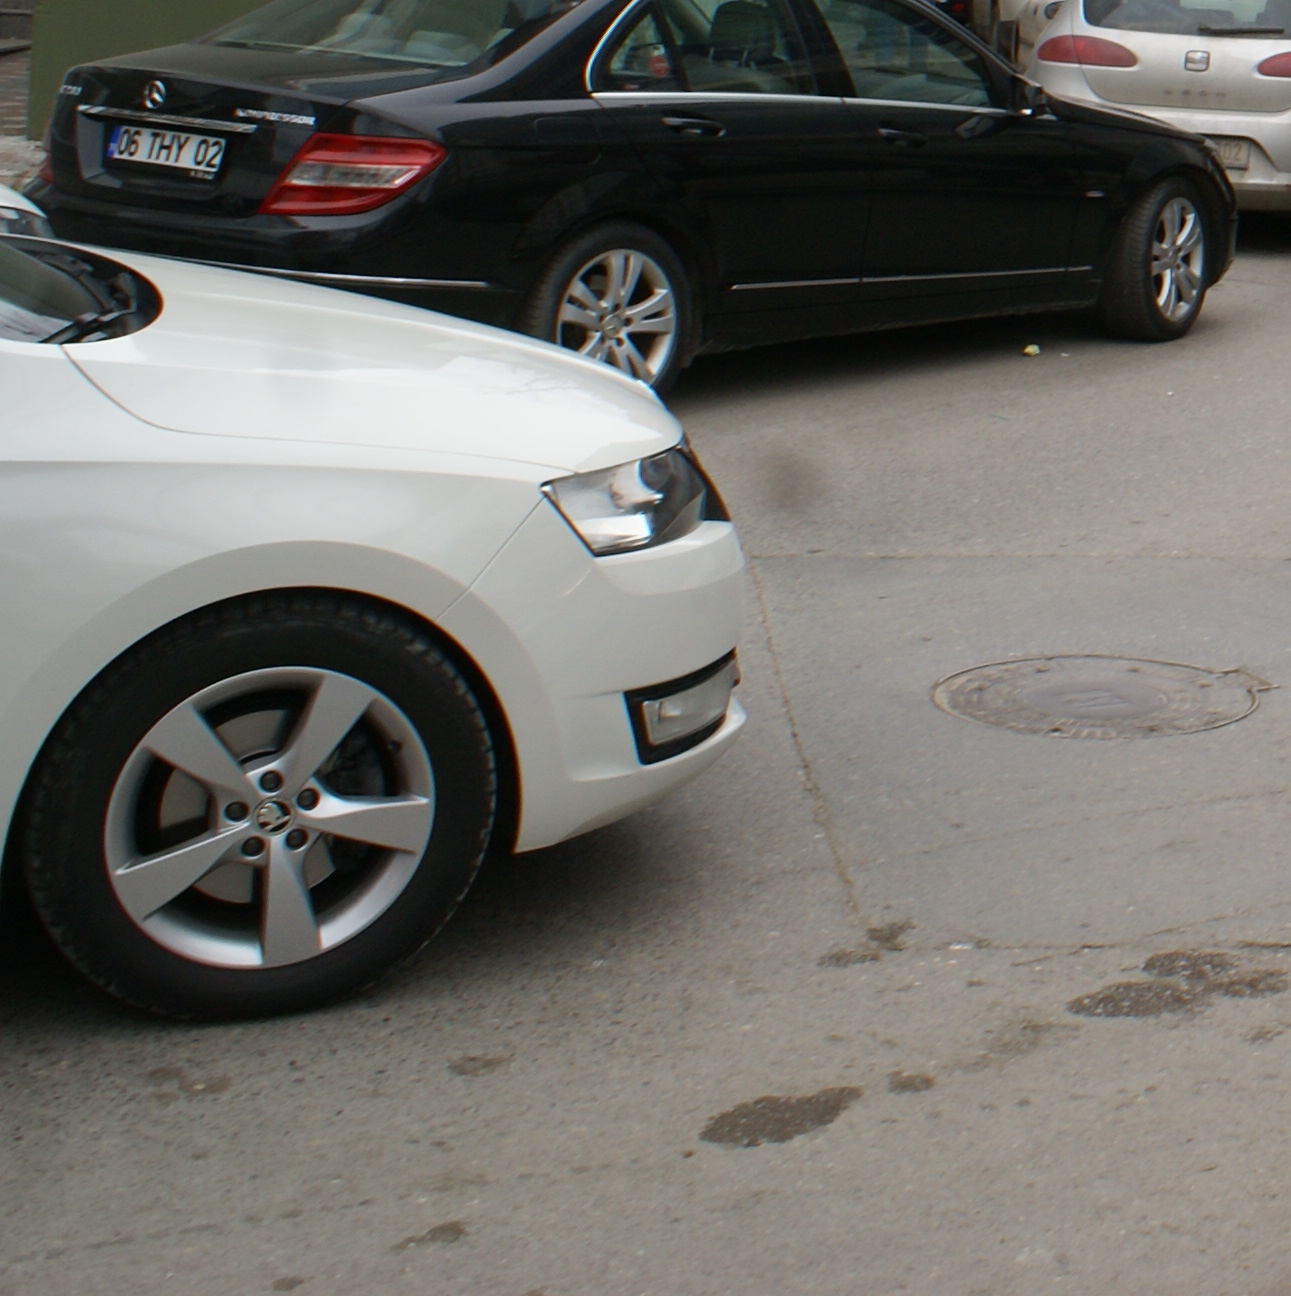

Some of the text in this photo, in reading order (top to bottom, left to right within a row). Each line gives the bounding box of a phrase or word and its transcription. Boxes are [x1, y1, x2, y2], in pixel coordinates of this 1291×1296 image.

[116, 128, 224, 169] 06 THY 02
